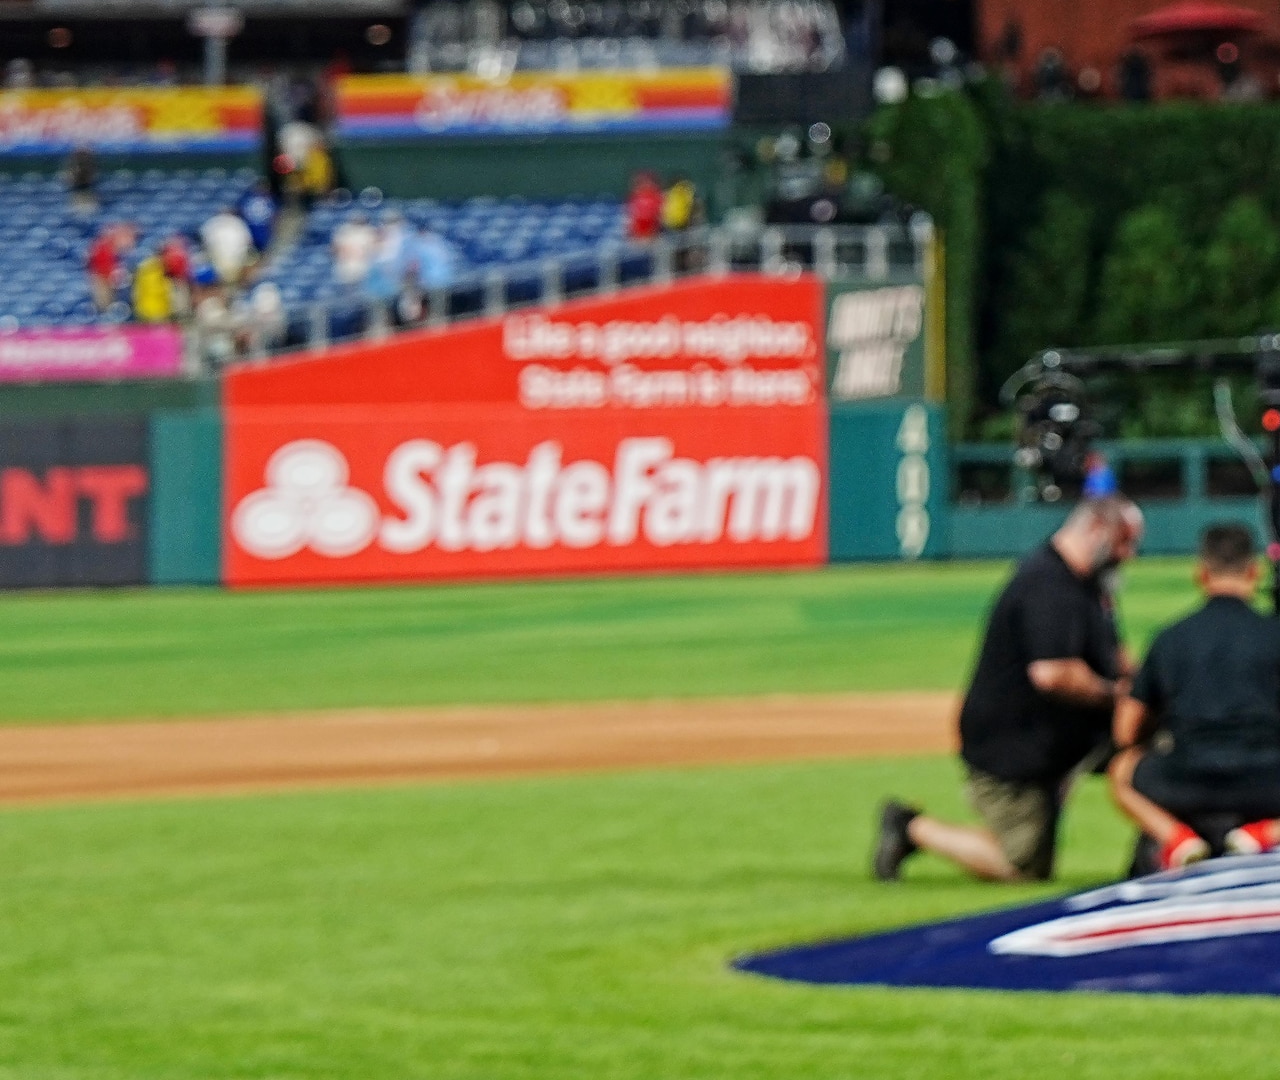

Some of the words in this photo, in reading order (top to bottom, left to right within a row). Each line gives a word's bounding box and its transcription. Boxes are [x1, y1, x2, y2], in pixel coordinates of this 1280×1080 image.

[503, 313, 576, 360] Like
[579, 321, 599, 356] a
[601, 313, 682, 364] good
[519, 364, 607, 409] State
[609, 363, 688, 408] Farm
[691, 361, 727, 406] is
